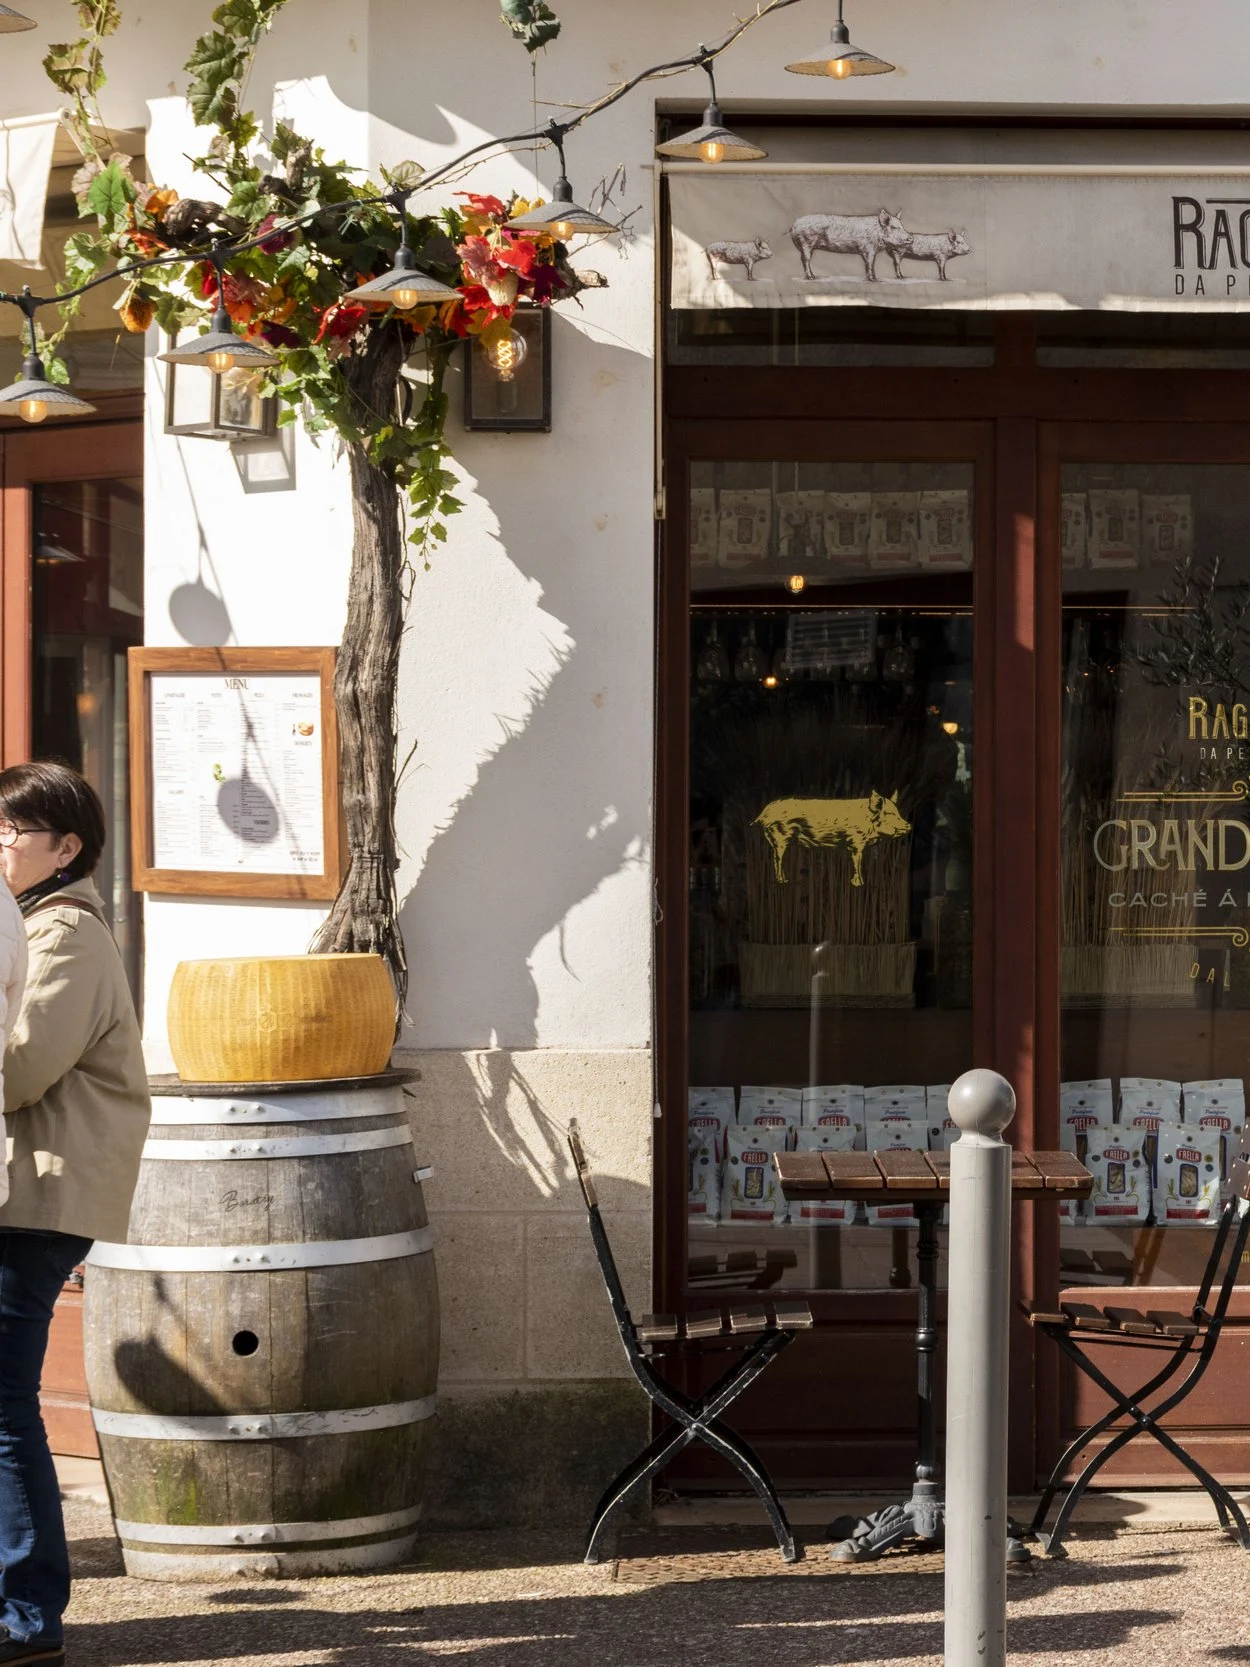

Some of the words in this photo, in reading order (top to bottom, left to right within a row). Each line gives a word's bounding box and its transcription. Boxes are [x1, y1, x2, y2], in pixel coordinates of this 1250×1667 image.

[1175, 274, 1206, 296] DA
[224, 678, 249, 690] MENU
[1200, 747, 1217, 760] DA
[1108, 889, 1207, 908] CACHÉ
[1189, 962, 1231, 987] DAL
[1178, 1150, 1200, 1162] FAELLA
